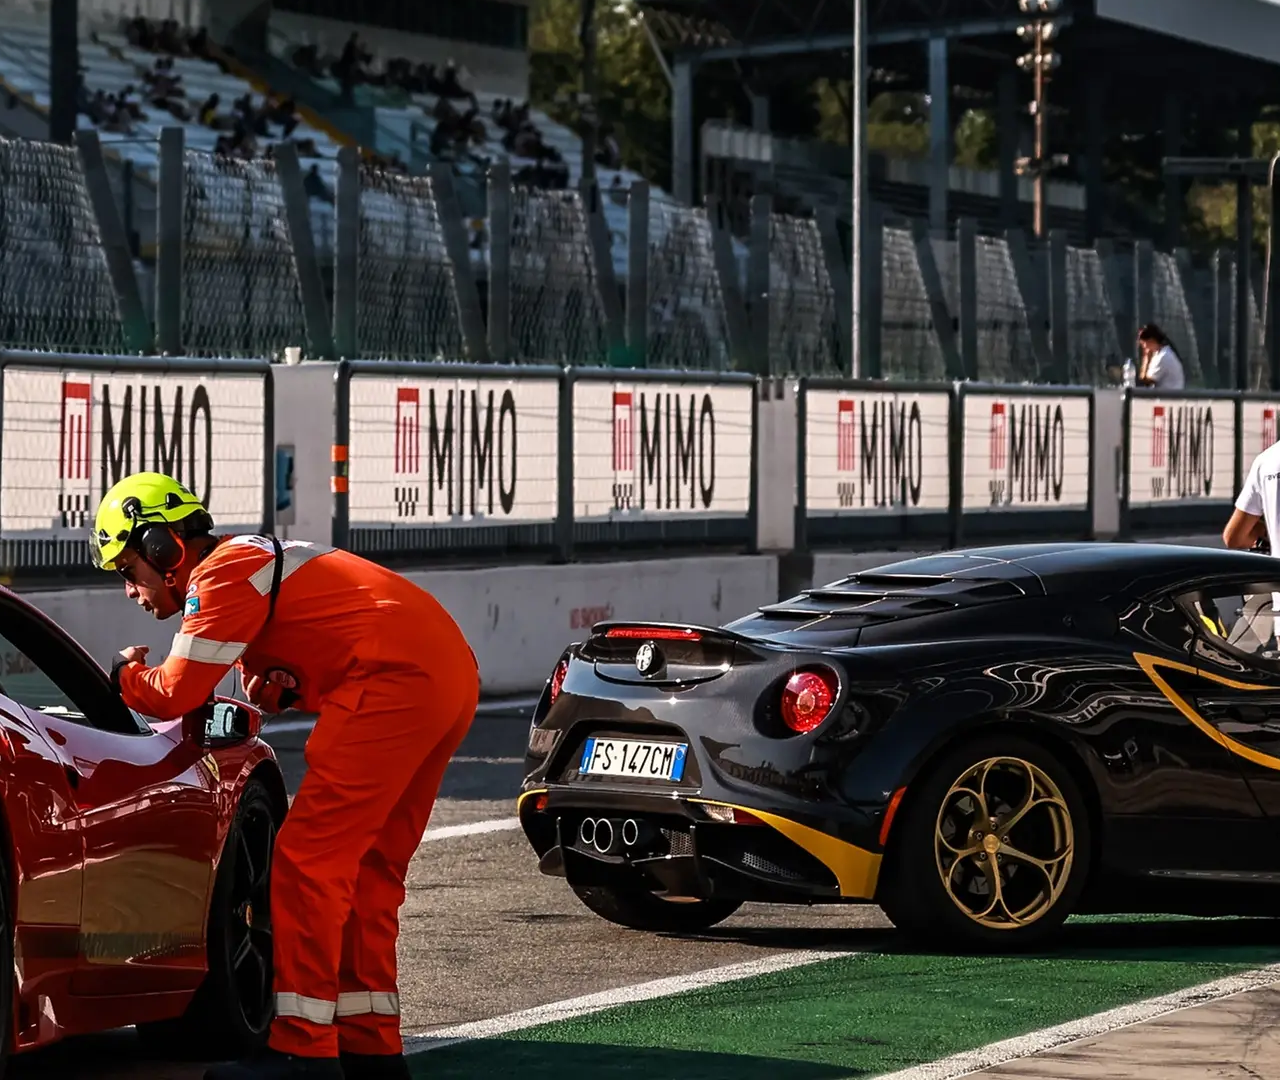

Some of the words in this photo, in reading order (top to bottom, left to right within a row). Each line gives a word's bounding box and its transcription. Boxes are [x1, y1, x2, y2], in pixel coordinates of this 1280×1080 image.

[97, 384, 212, 512] MIMO
[428, 388, 518, 516] MIMO
[640, 392, 715, 510] MIMO
[860, 400, 922, 506] MIMO
[1010, 404, 1064, 502] MIMO
[1169, 406, 1214, 497] MIMO
[591, 742, 614, 770] FS
[621, 744, 674, 776] 147CM
